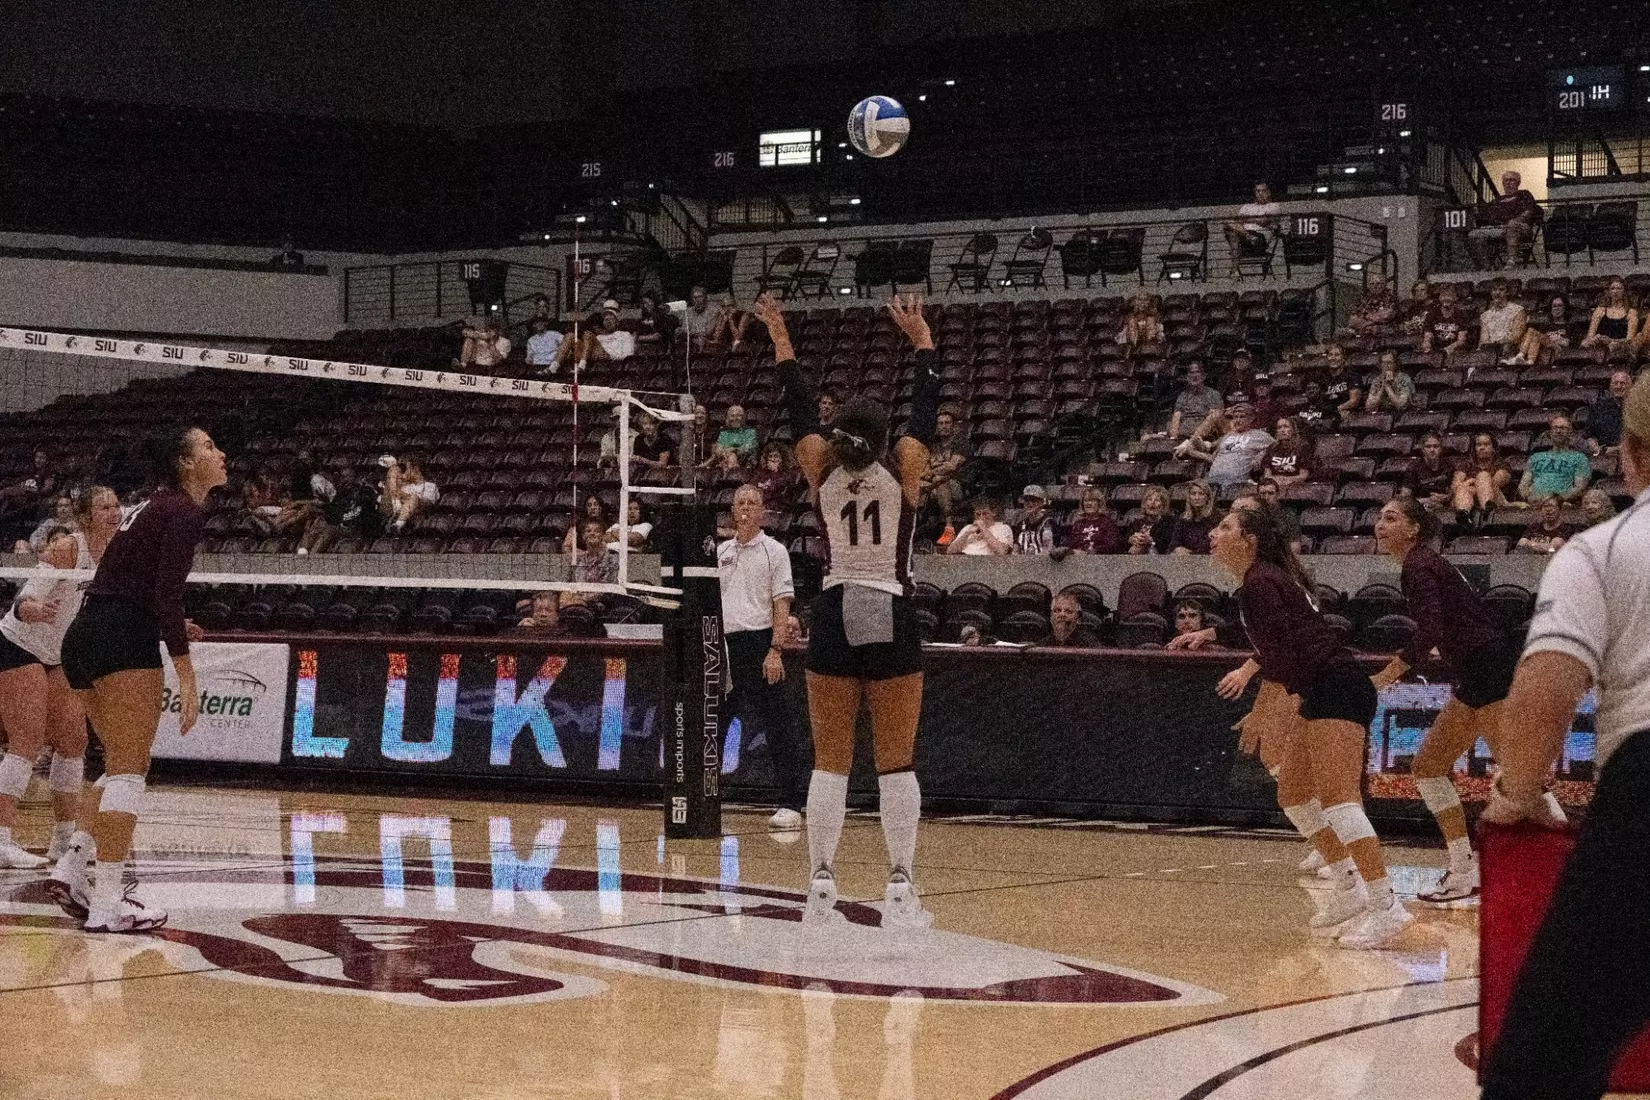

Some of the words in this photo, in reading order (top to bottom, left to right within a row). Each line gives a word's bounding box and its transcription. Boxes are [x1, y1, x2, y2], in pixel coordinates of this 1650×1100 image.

[1559, 91, 1585, 109] 201
[1381, 103, 1407, 120] 216
[714, 152, 735, 167] 216
[582, 162, 601, 177] 215
[1297, 217, 1320, 235] 116
[1445, 211, 1467, 228] 101
[464, 263, 480, 279] 115
[24, 332, 48, 346] SIU
[95, 340, 118, 353] SIU
[162, 347, 184, 359] SIU
[227, 352, 249, 364] SIU
[288, 359, 309, 371] SIU
[348, 365, 368, 376] SIU
[405, 370, 424, 381] SIU
[459, 375, 478, 387] SIU
[511, 380, 530, 391] SIU
[1271, 455, 1297, 466] SIU
[840, 500, 881, 546] 11
[161, 687, 253, 716] Baterra
[702, 615, 721, 797] SALUKIS
[292, 650, 742, 775] LUKI
[675, 702, 684, 737] sports
[675, 740, 684, 783] imports
